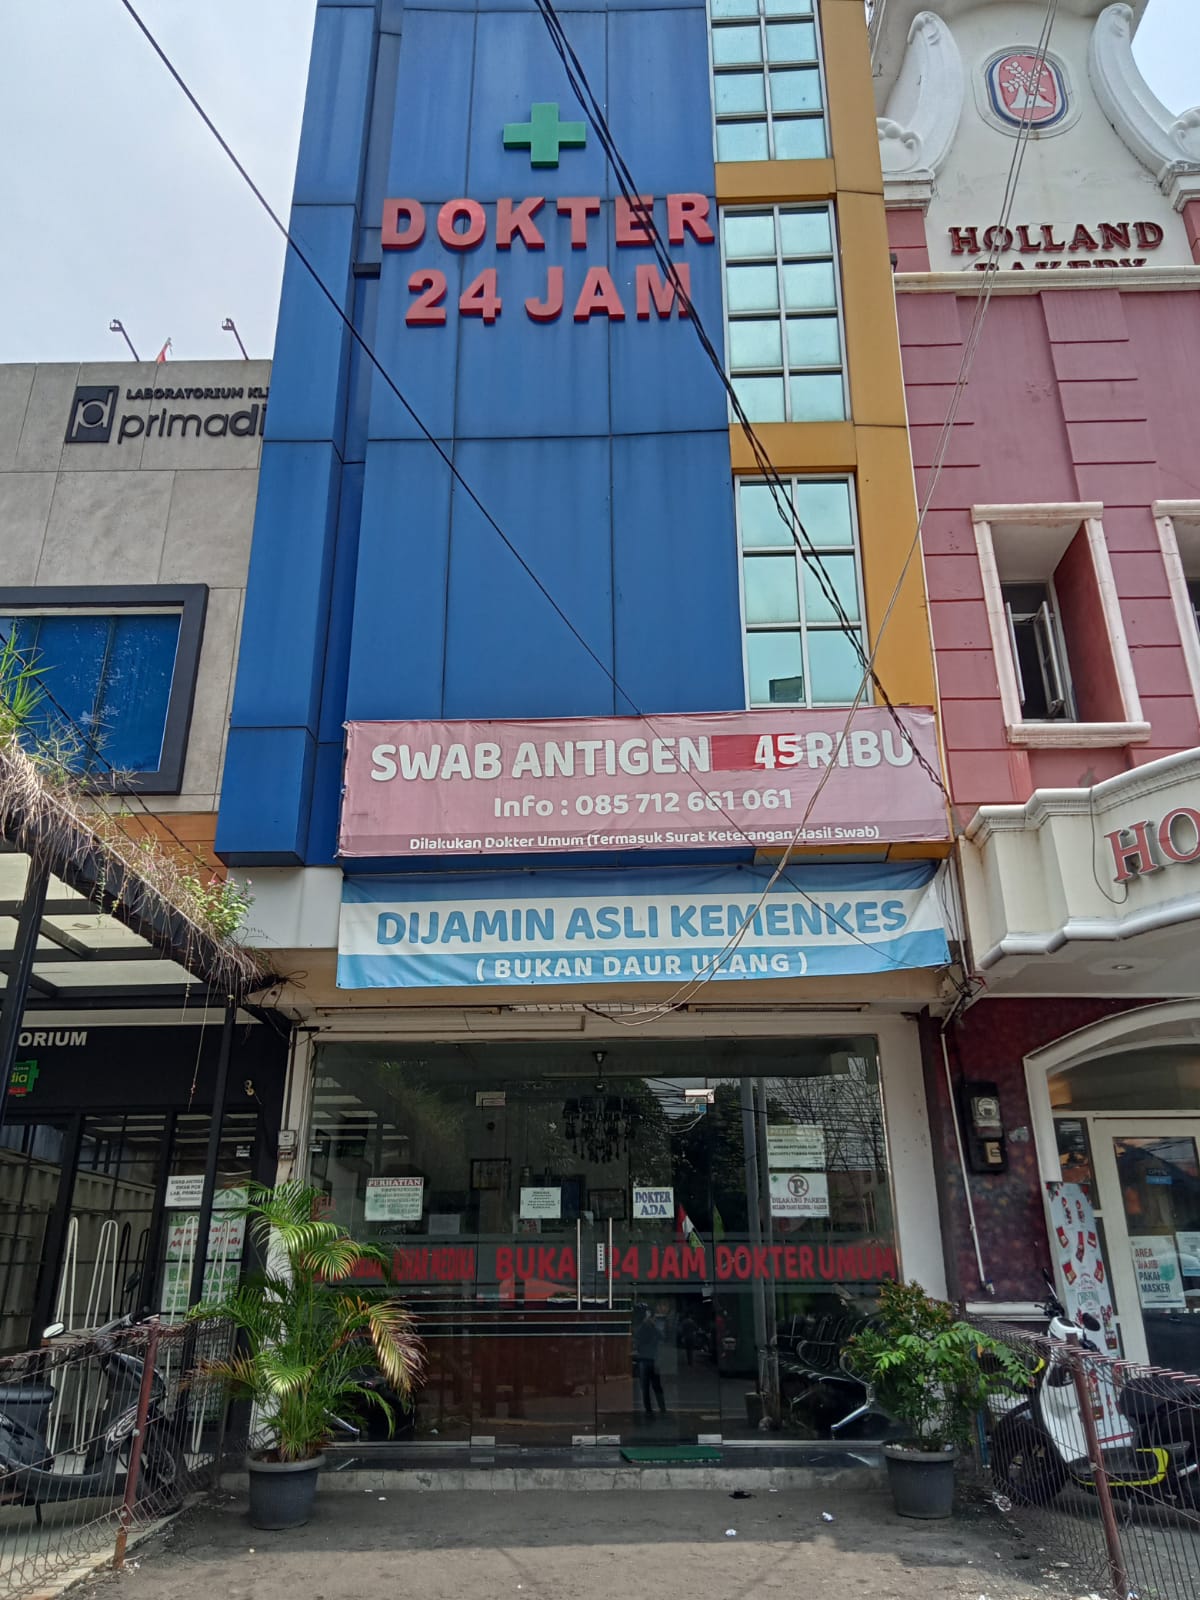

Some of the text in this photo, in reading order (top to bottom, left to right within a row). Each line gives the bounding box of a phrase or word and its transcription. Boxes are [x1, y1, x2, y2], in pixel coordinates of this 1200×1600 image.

[381, 192, 715, 251] DOKTER
[948, 221, 1164, 254] HOLLAND
[405, 263, 692, 326] 24 JAM
[126, 387, 244, 400] LABORATORIUM
[370, 742, 503, 782] SWAB
[512, 735, 711, 779] ANTIGEN
[494, 795, 553, 817] Info
[575, 794, 629, 816] 085
[637, 792, 680, 813] 712
[687, 790, 735, 812] 661
[742, 788, 792, 810] 061
[410, 825, 880, 850] Dilakukan Dokter Umum (Termasuk Surat Keterangan Hasil Swab)
[376, 900, 907, 945] DIJAMIN ASLI KEMENKES
[495, 956, 592, 979] BUKAN
[603, 955, 681, 976] DAUR
[691, 953, 790, 975] ULANG
[18, 1031, 88, 1047] ORIUM
[635, 1191, 671, 1203] DOKTER
[640, 1204, 667, 1216] ADA
[495, 1244, 897, 1281] BUKA 24 JAM DOKTER UMUM
[1135, 1248, 1153, 1258] AREA
[1141, 1283, 1171, 1294] MASKER
